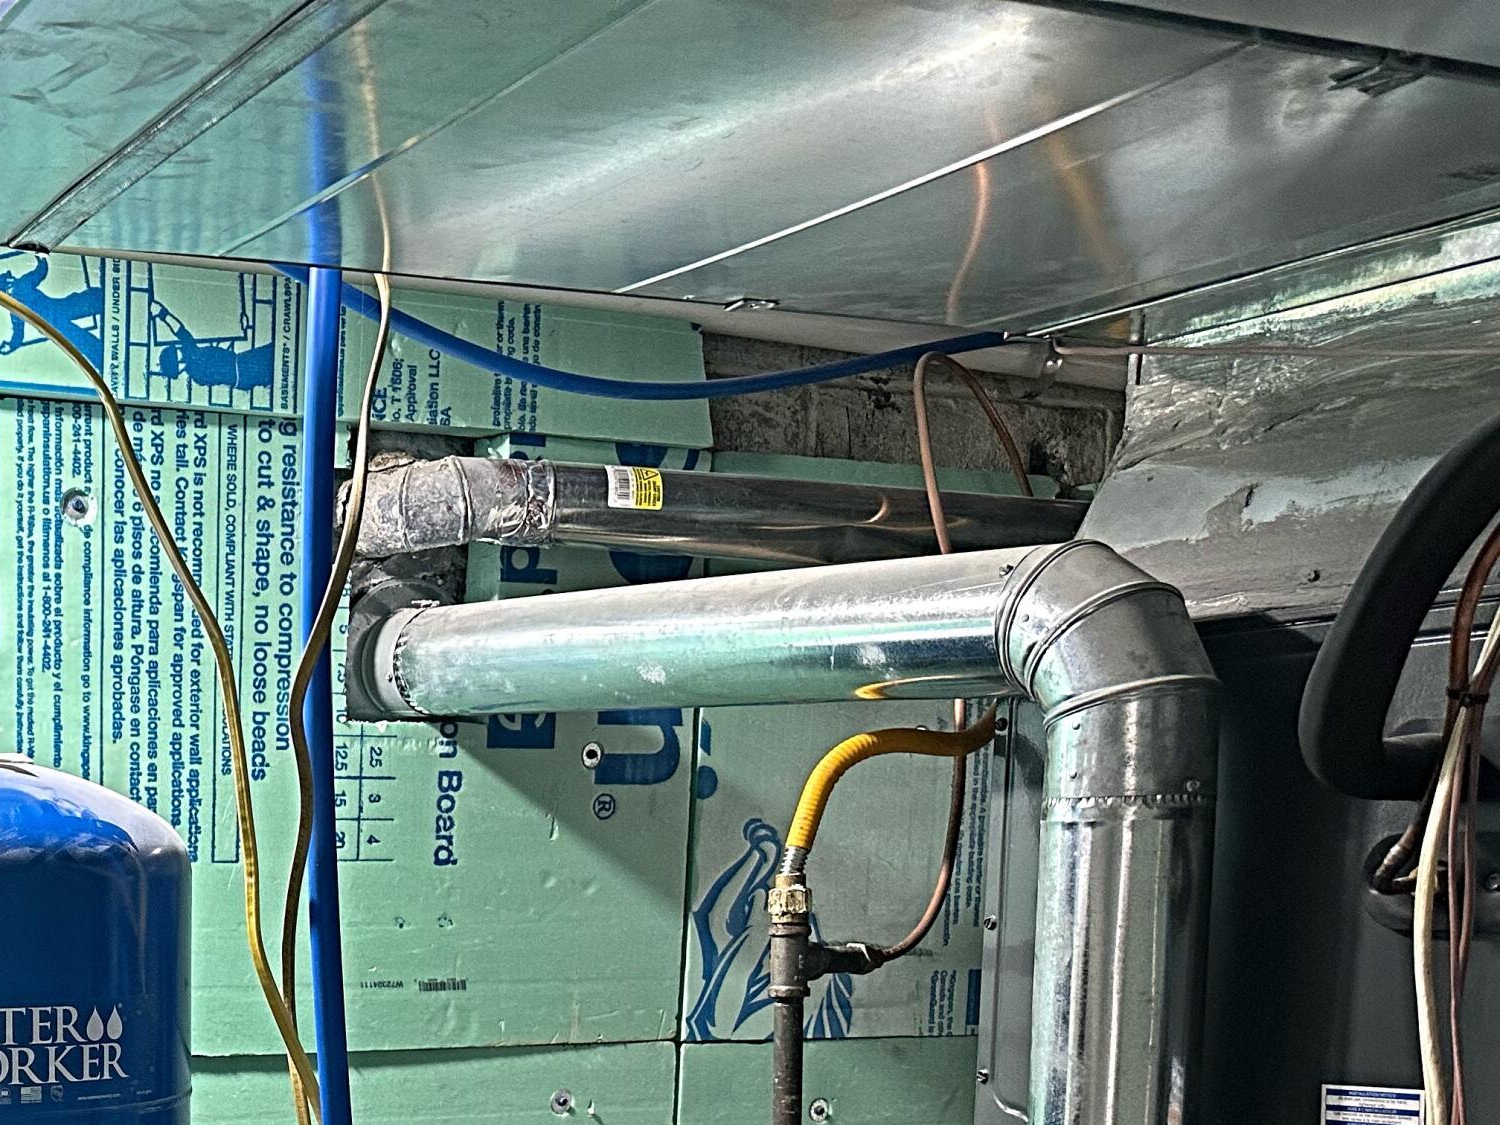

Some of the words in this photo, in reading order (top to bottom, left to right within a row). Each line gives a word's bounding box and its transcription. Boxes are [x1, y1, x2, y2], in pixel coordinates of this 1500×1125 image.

[112, 277, 120, 313] UNDER
[429, 349, 441, 377] LLC
[405, 365, 417, 421] Approval
[149, 429, 164, 466] XPS
[174, 442, 190, 473] tall.
[193, 433, 207, 468] XPS
[225, 425, 237, 471] WHERE
[149, 470, 162, 490] no
[192, 471, 206, 485] is
[256, 450, 274, 488] cut
[174, 477, 188, 543] Contact
[191, 490, 206, 518] not
[224, 473, 237, 511] SOLD,
[257, 495, 275, 512] &
[278, 444, 297, 566] resistance
[113, 521, 128, 544] las
[128, 516, 146, 557] pisos
[224, 514, 236, 587] COMPLIANT
[130, 561, 147, 586] de
[251, 519, 274, 597] shape,
[110, 548, 127, 650] aplicaciones
[279, 572, 297, 595] to
[224, 591, 236, 621] WITH
[254, 605, 269, 634] no
[145, 619, 162, 655] para
[171, 626, 186, 645] for
[189, 642, 205, 666] for
[127, 643, 147, 714] Póngase
[168, 653, 186, 728] approved
[253, 641, 271, 704] loose
[272, 603, 295, 750] compression
[111, 654, 126, 744] aprobadas.
[146, 660, 163, 758] aplicaciones
[188, 670, 204, 729] exterior
[189, 734, 203, 763] wall
[250, 711, 270, 781] beads
[336, 742, 349, 771] 12.5
[369, 746, 383, 768] 2.5
[433, 770, 464, 866] Board
